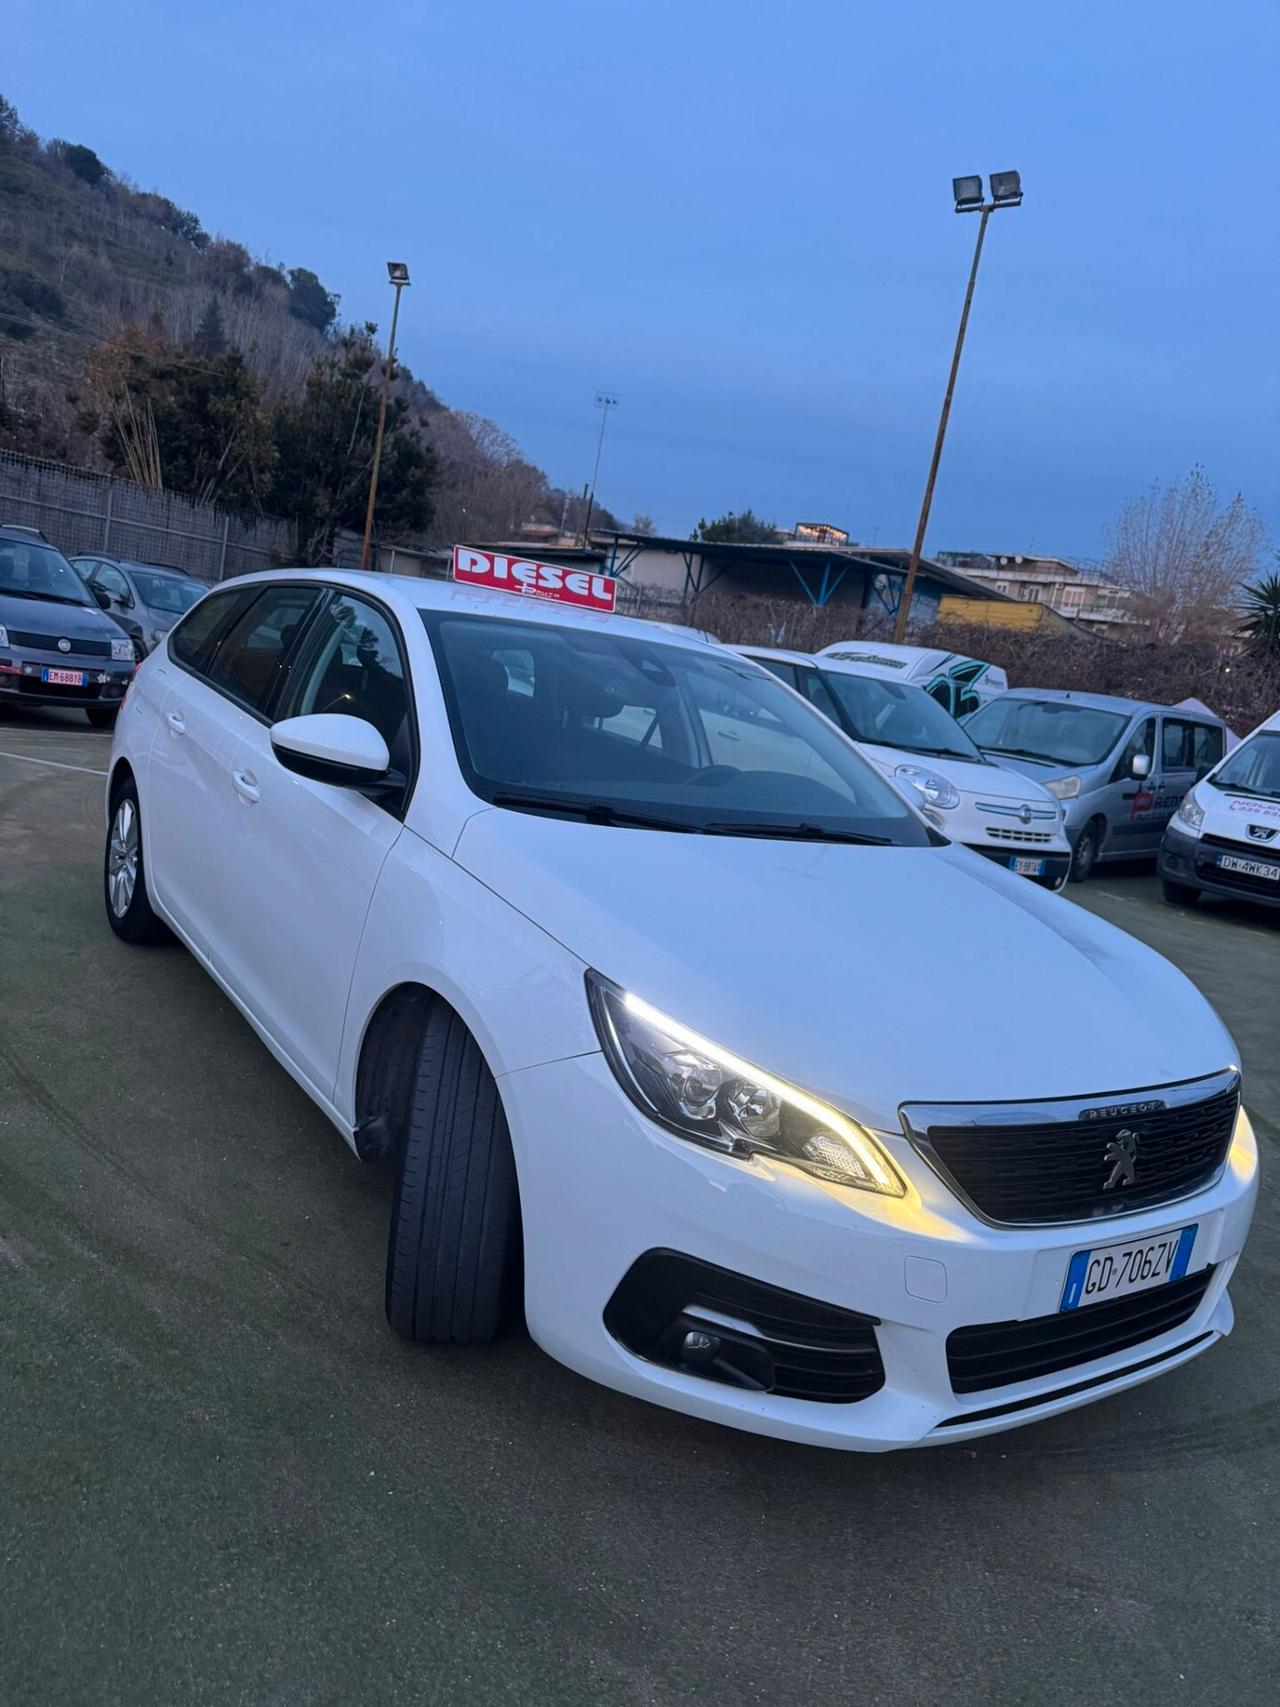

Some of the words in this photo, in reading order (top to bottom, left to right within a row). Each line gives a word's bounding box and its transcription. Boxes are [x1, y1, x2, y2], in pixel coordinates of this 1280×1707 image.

[457, 549, 612, 601] DIESEL
[1232, 800, 1280, 812] NOLE
[1089, 1102, 1156, 1119] PEUGEOT
